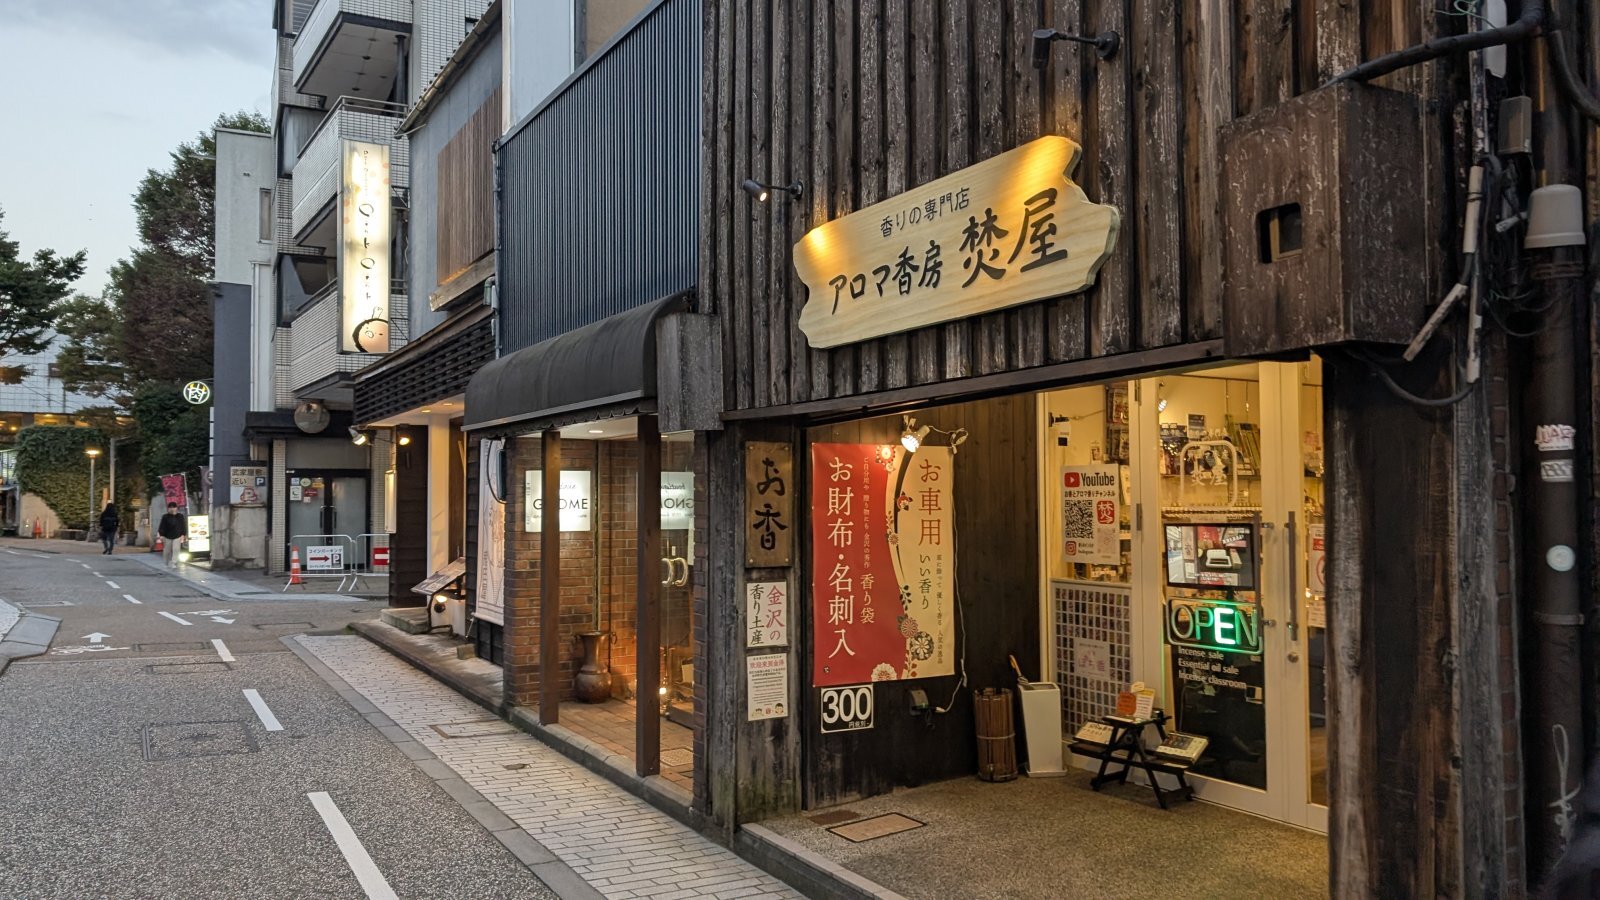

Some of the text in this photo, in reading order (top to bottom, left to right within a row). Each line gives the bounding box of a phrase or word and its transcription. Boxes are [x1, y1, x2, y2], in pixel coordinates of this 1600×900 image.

[880, 187, 971, 238] 香りの専門店
[828, 187, 1069, 315] アロマ香房 焚屋
[256, 477, 264, 486] P
[533, 498, 588, 510] GOME
[752, 457, 789, 551] お香
[918, 459, 942, 546] お車用
[1080, 472, 1115, 487] YouTube
[827, 456, 856, 659] お財布・名刺入
[918, 554, 932, 610] いい香り
[749, 584, 765, 645] 香り土産
[765, 585, 785, 640] 金沢の
[860, 574, 875, 624] 香り袋
[1171, 604, 1257, 647] OPEN
[1178, 646, 1225, 660] Incense sale
[1178, 658, 1240, 675] Essential oil sale
[1178, 669, 1247, 689] Incense classroom
[823, 687, 872, 724] 300
